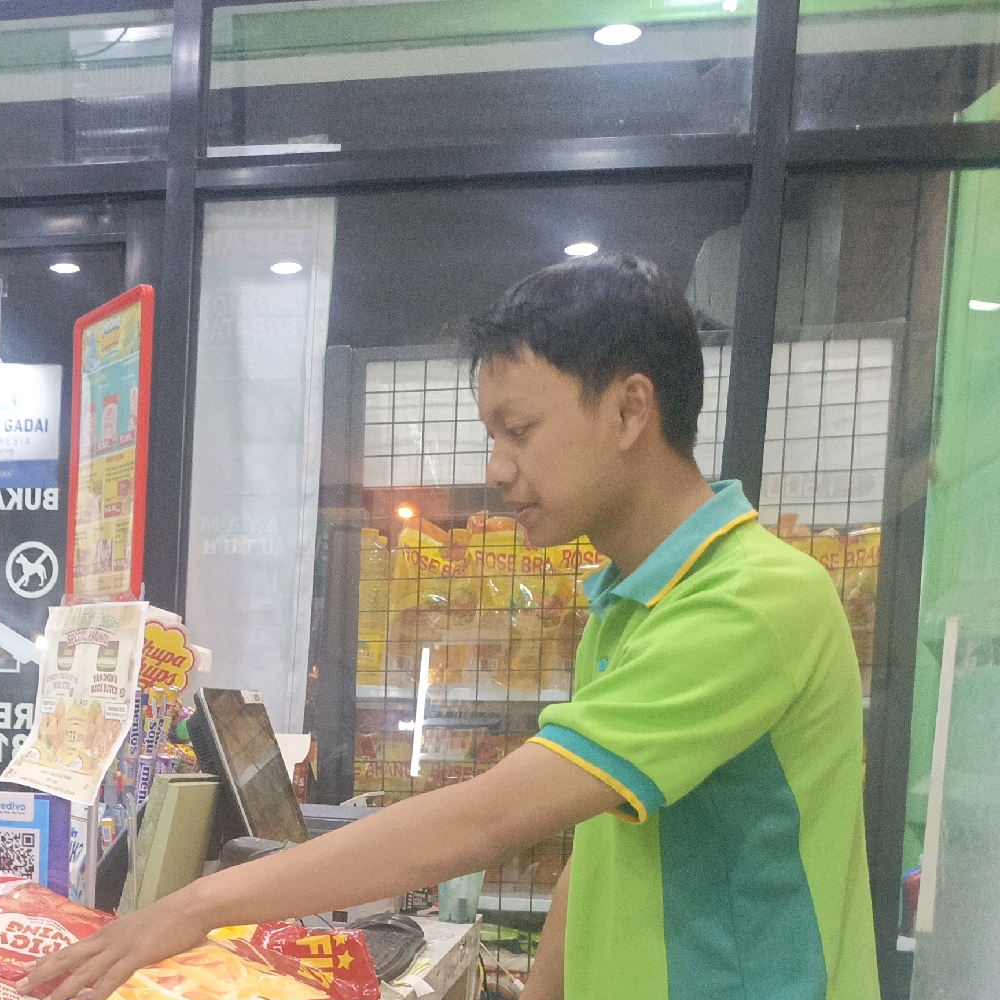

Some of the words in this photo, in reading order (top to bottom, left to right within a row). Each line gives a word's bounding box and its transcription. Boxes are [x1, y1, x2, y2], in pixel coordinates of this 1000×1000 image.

[4, 418, 48, 433] GADAI
[403, 542, 440, 574] ROSE
[475, 550, 516, 573] ROSE
[143, 638, 187, 668] hupa
[140, 660, 178, 687] hups
[130, 697, 141, 756] mentos
